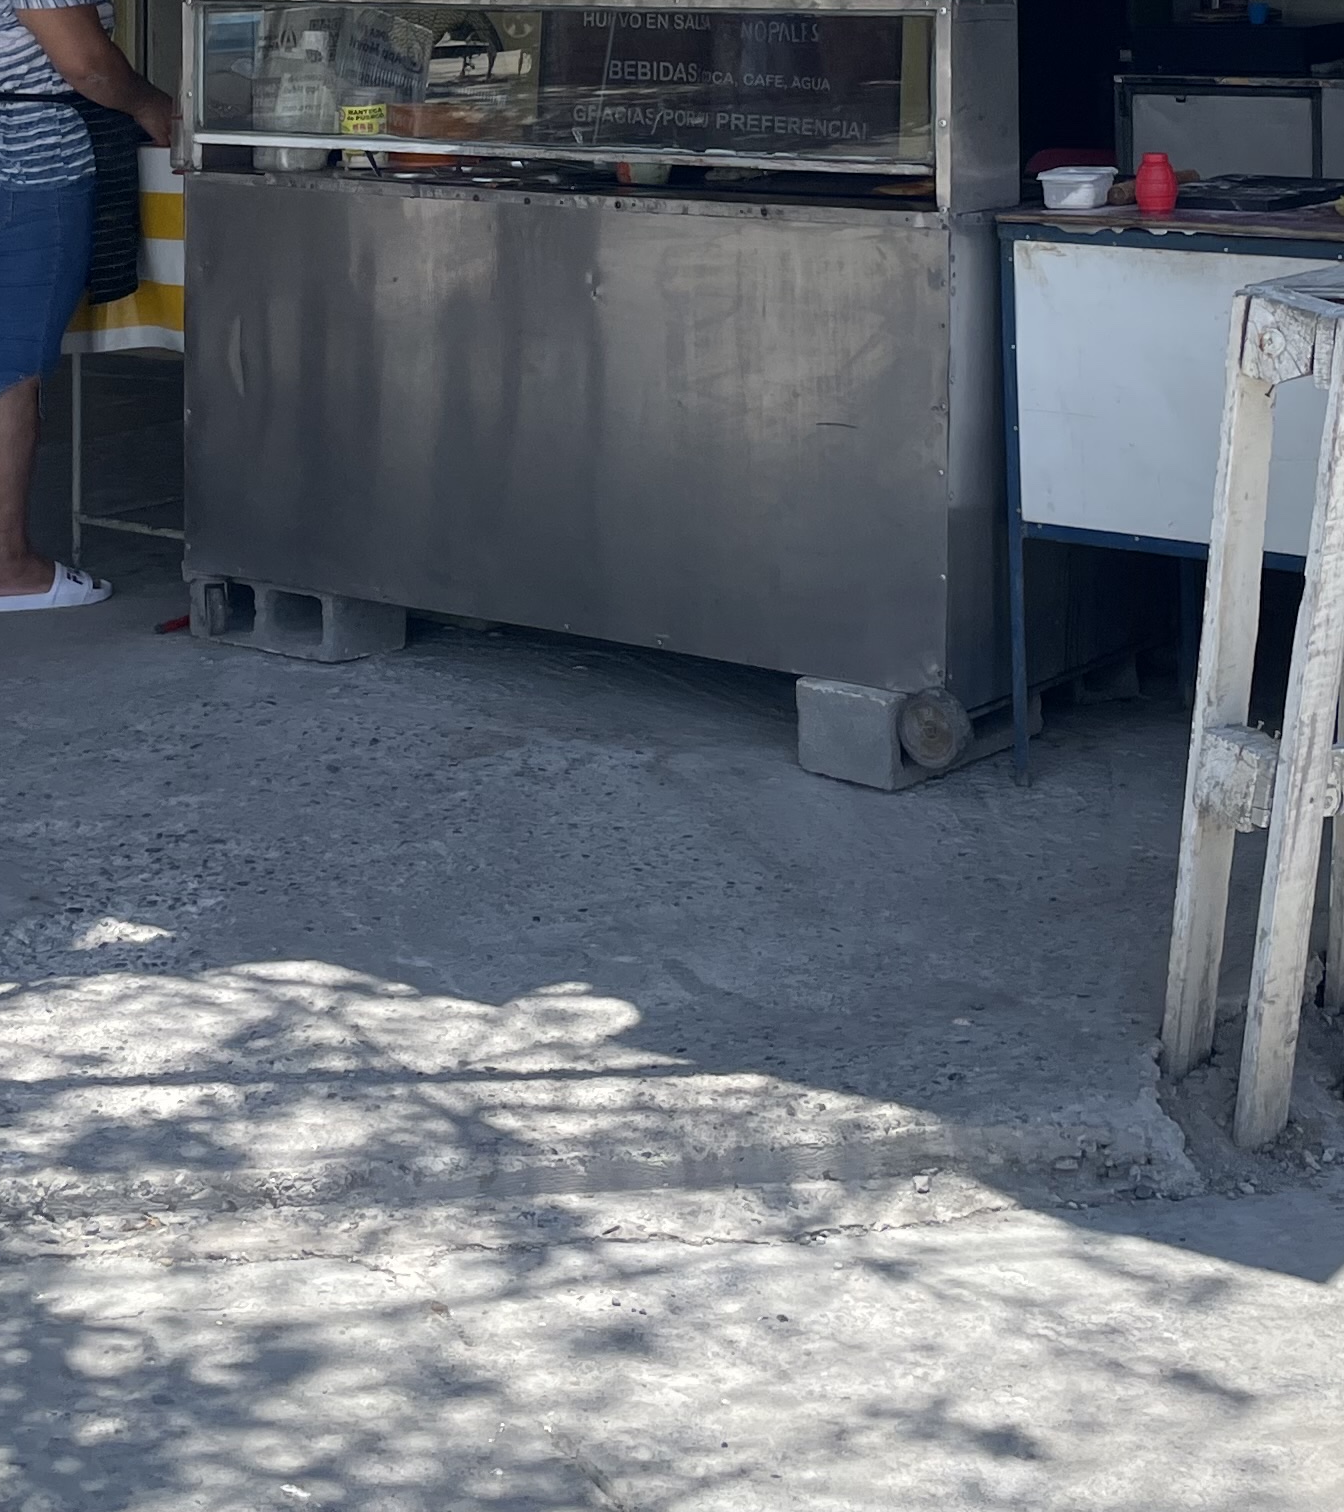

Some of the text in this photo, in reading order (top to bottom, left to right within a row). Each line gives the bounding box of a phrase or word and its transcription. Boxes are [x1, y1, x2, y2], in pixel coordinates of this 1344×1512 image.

[646, 12, 670, 30] EN
[740, 21, 820, 44] NOPALES
[608, 60, 698, 82] BEBIDAS
[790, 75, 831, 92] AGUA
